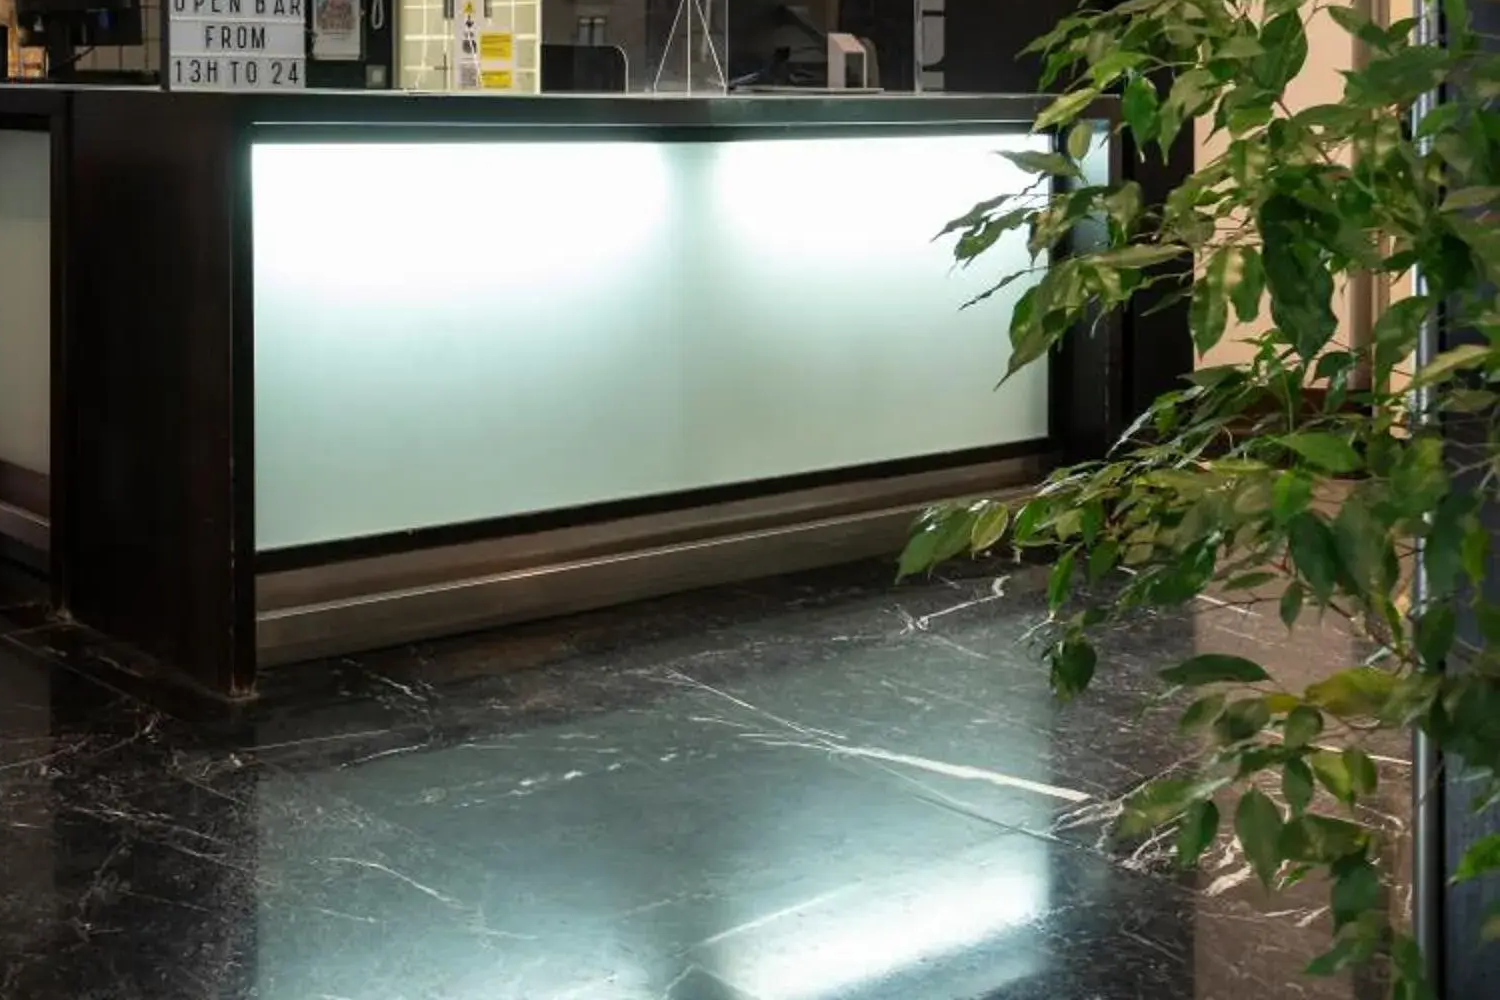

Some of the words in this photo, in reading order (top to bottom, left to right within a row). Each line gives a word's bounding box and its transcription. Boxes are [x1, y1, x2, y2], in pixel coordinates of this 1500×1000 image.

[204, 25, 266, 49] FROM
[175, 59, 219, 84] 13H
[230, 61, 258, 84] TO
[270, 61, 300, 85] 24
